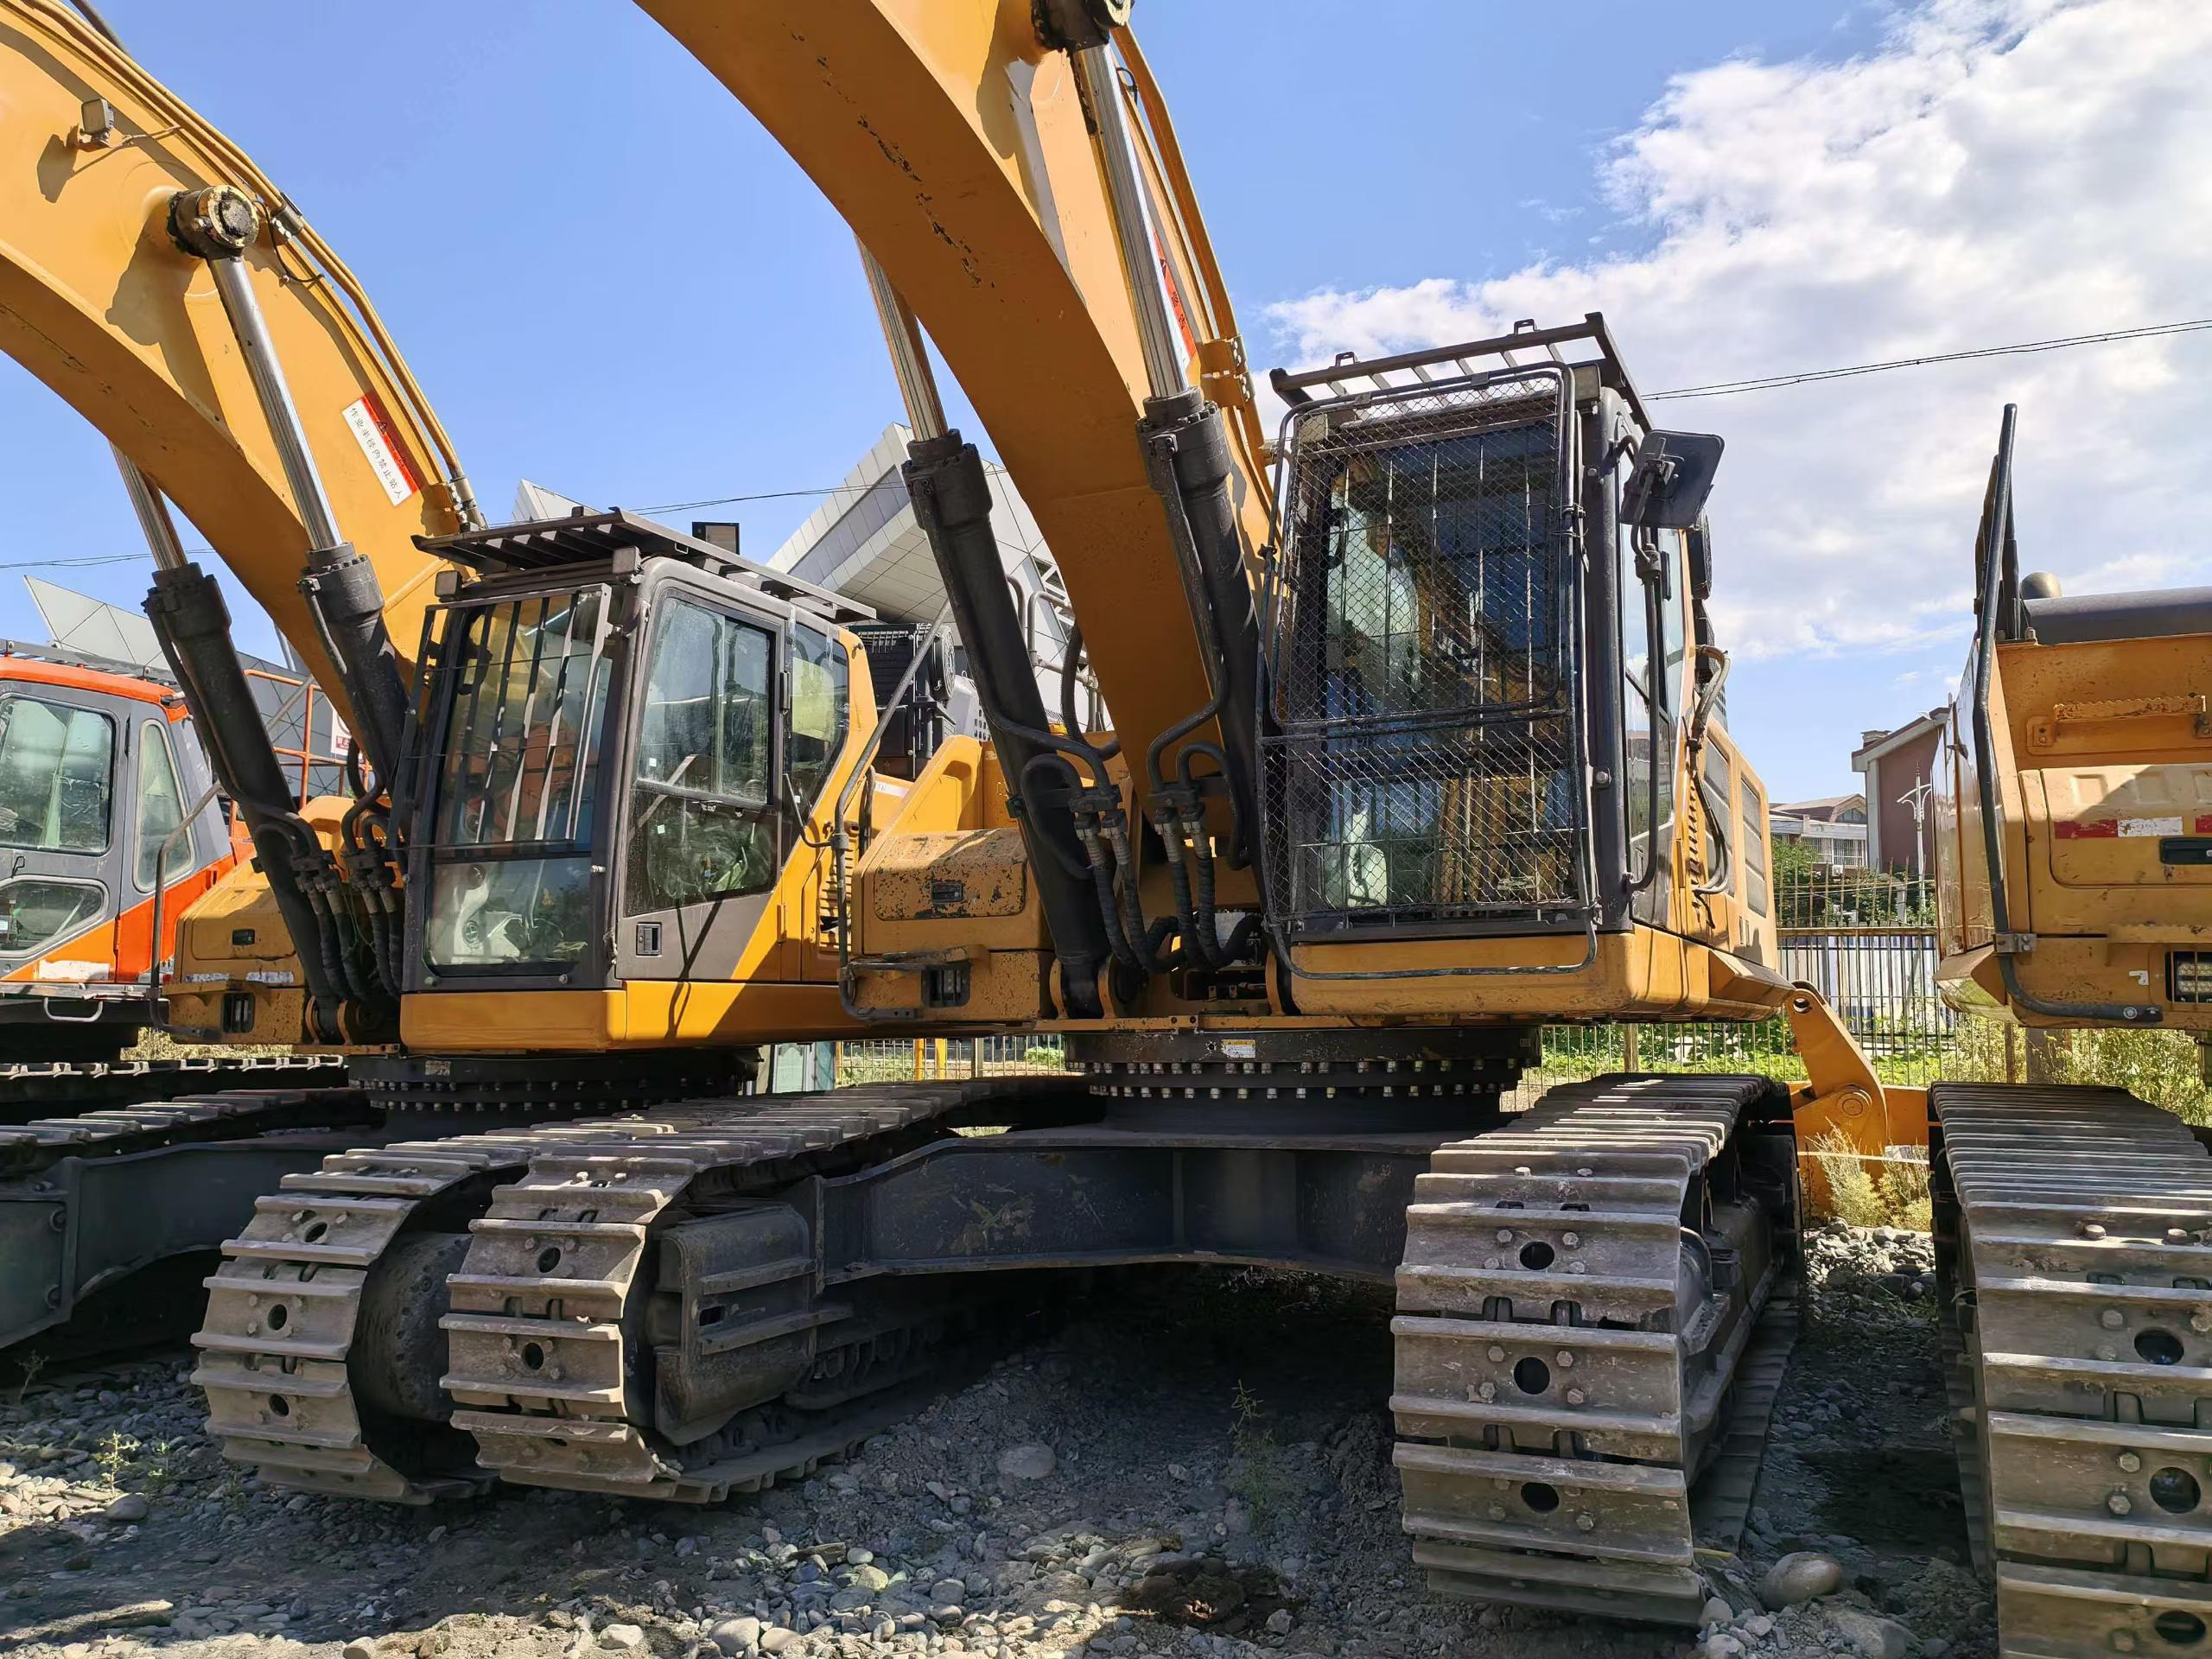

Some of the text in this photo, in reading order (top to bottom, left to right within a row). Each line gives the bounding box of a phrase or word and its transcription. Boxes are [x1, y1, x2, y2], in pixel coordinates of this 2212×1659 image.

[349, 407, 403, 499] 作业半径内禁止站人
